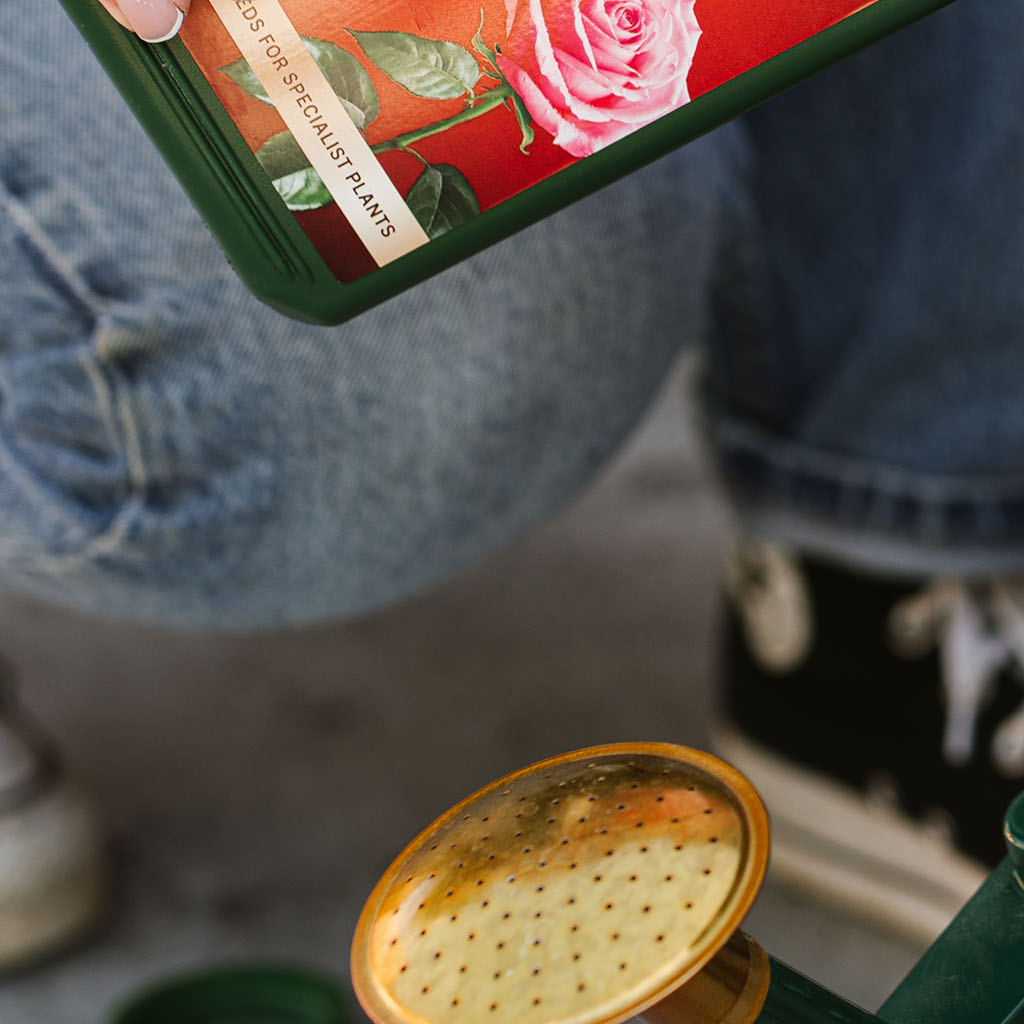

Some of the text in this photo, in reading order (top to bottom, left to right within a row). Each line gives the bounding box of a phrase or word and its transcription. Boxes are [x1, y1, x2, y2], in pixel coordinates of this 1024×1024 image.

[258, 34, 289, 72] FOR
[282, 72, 354, 170] SPECIALIST
[344, 174, 396, 239] PLANTS
